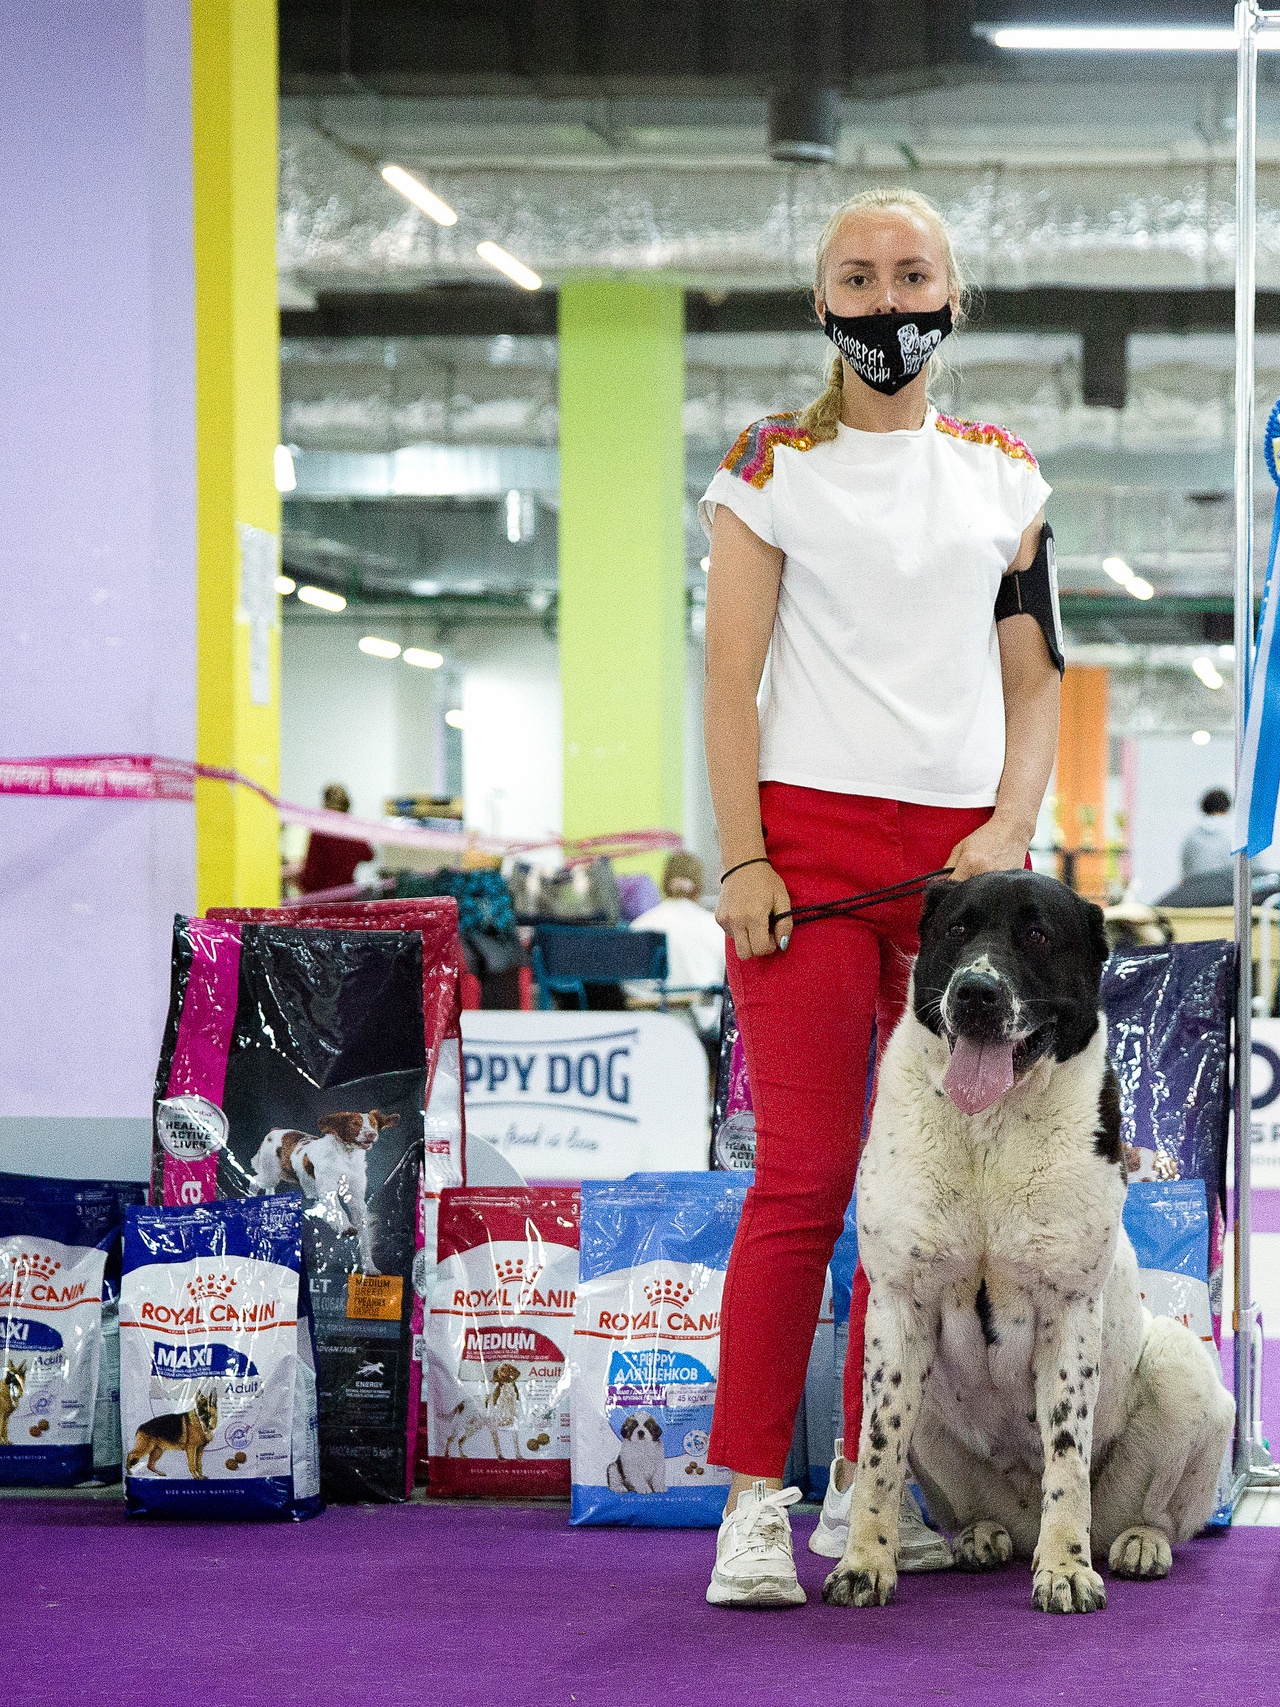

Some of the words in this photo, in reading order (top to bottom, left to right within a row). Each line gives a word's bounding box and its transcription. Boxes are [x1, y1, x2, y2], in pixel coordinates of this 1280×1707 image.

[463, 1053, 536, 1092] PPY
[549, 1048, 631, 1104] DOG
[170, 1131, 211, 1140] ACTIVE
[453, 1288, 511, 1307] ROYAL
[142, 1301, 204, 1326] ROYAL
[210, 1301, 275, 1323] CANIN
[598, 1311, 660, 1331] ROYAL
[467, 1333, 536, 1350] MEDIUM
[157, 1347, 213, 1367] MAXI
[639, 1353, 676, 1367] PUPPY
[529, 1366, 562, 1378] Adult
[614, 1368, 641, 1383] ДЛЯ
[225, 1381, 259, 1394] Adult
